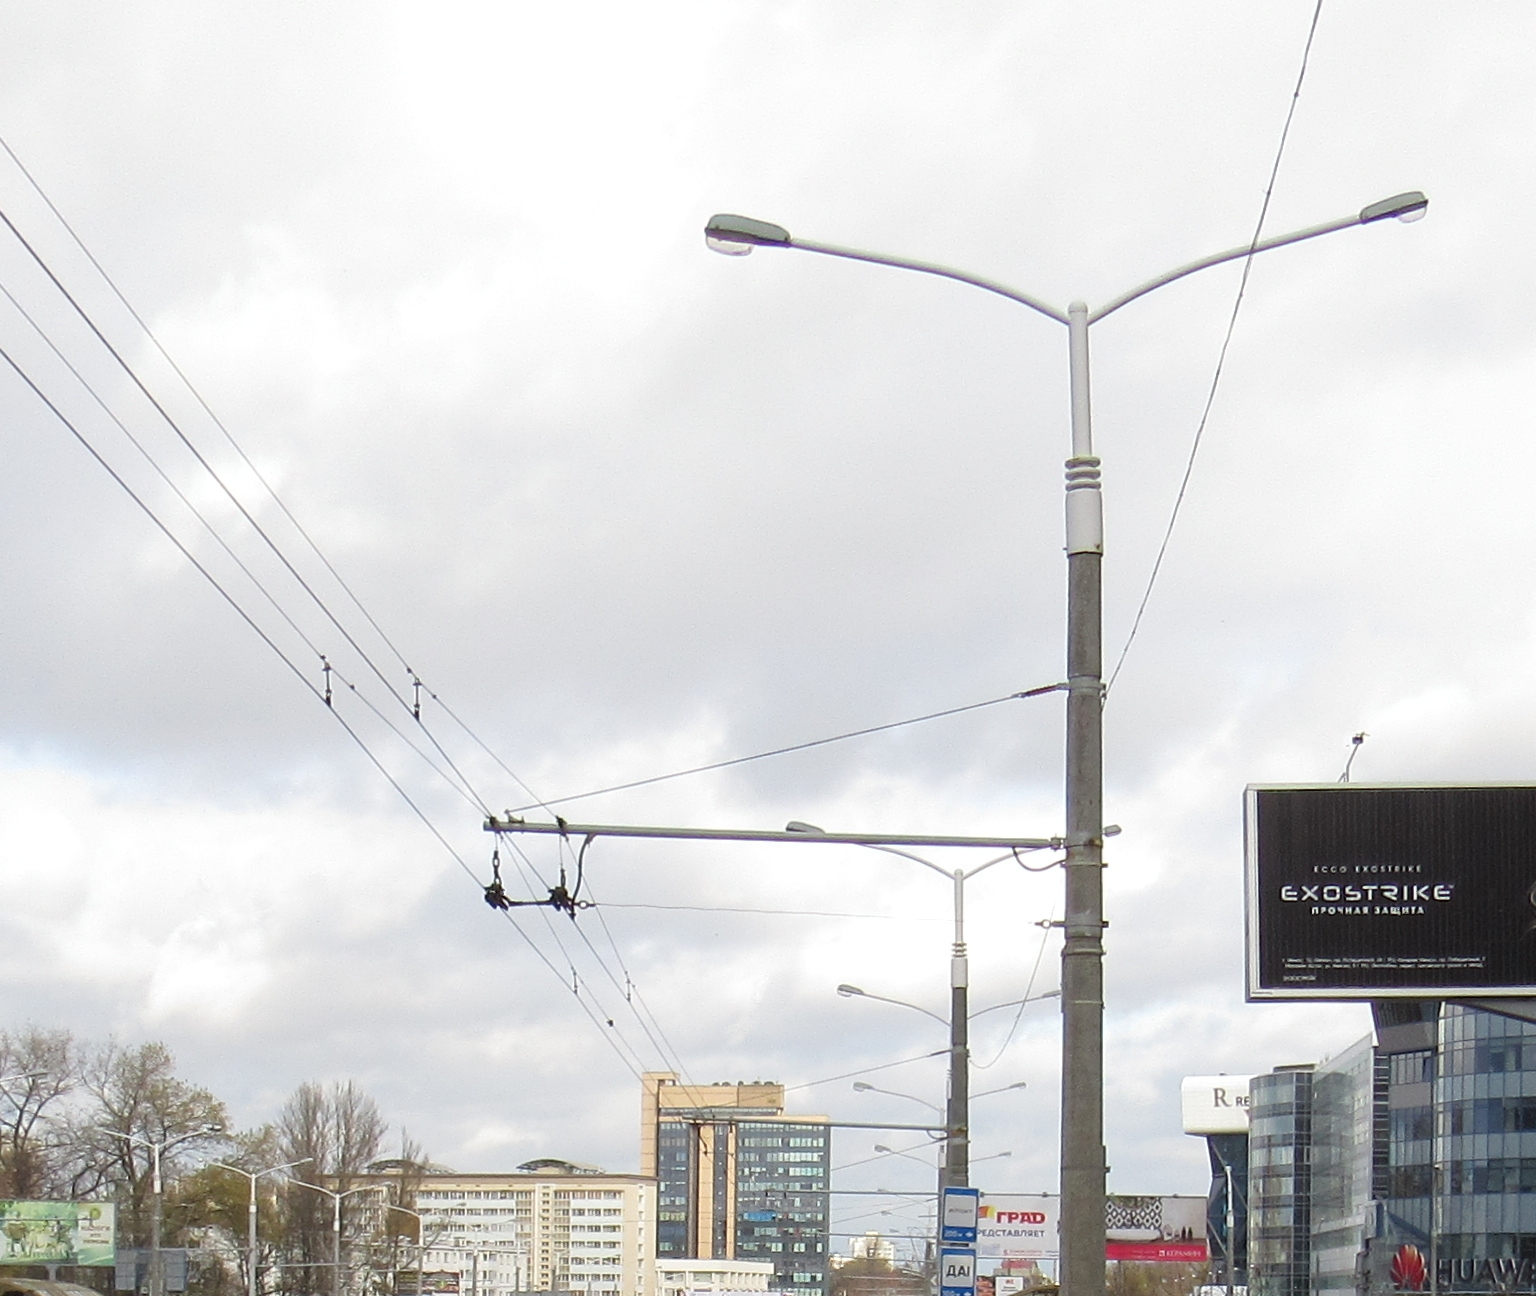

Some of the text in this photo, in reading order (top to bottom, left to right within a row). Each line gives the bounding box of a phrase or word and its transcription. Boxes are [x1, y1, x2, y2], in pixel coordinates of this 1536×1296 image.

[1313, 864, 1423, 874] ECCO EXOSTRIKE
[1280, 884, 1452, 902] EXOSTRIKE
[1311, 906, 1425, 916] ПРОЧНАЯ ЗАЩИТА
[1213, 1087, 1250, 1108] R RE
[996, 1211, 1046, 1225] ГРАД
[978, 1229, 1045, 1238] РЕДСТАВЛЯЕТ
